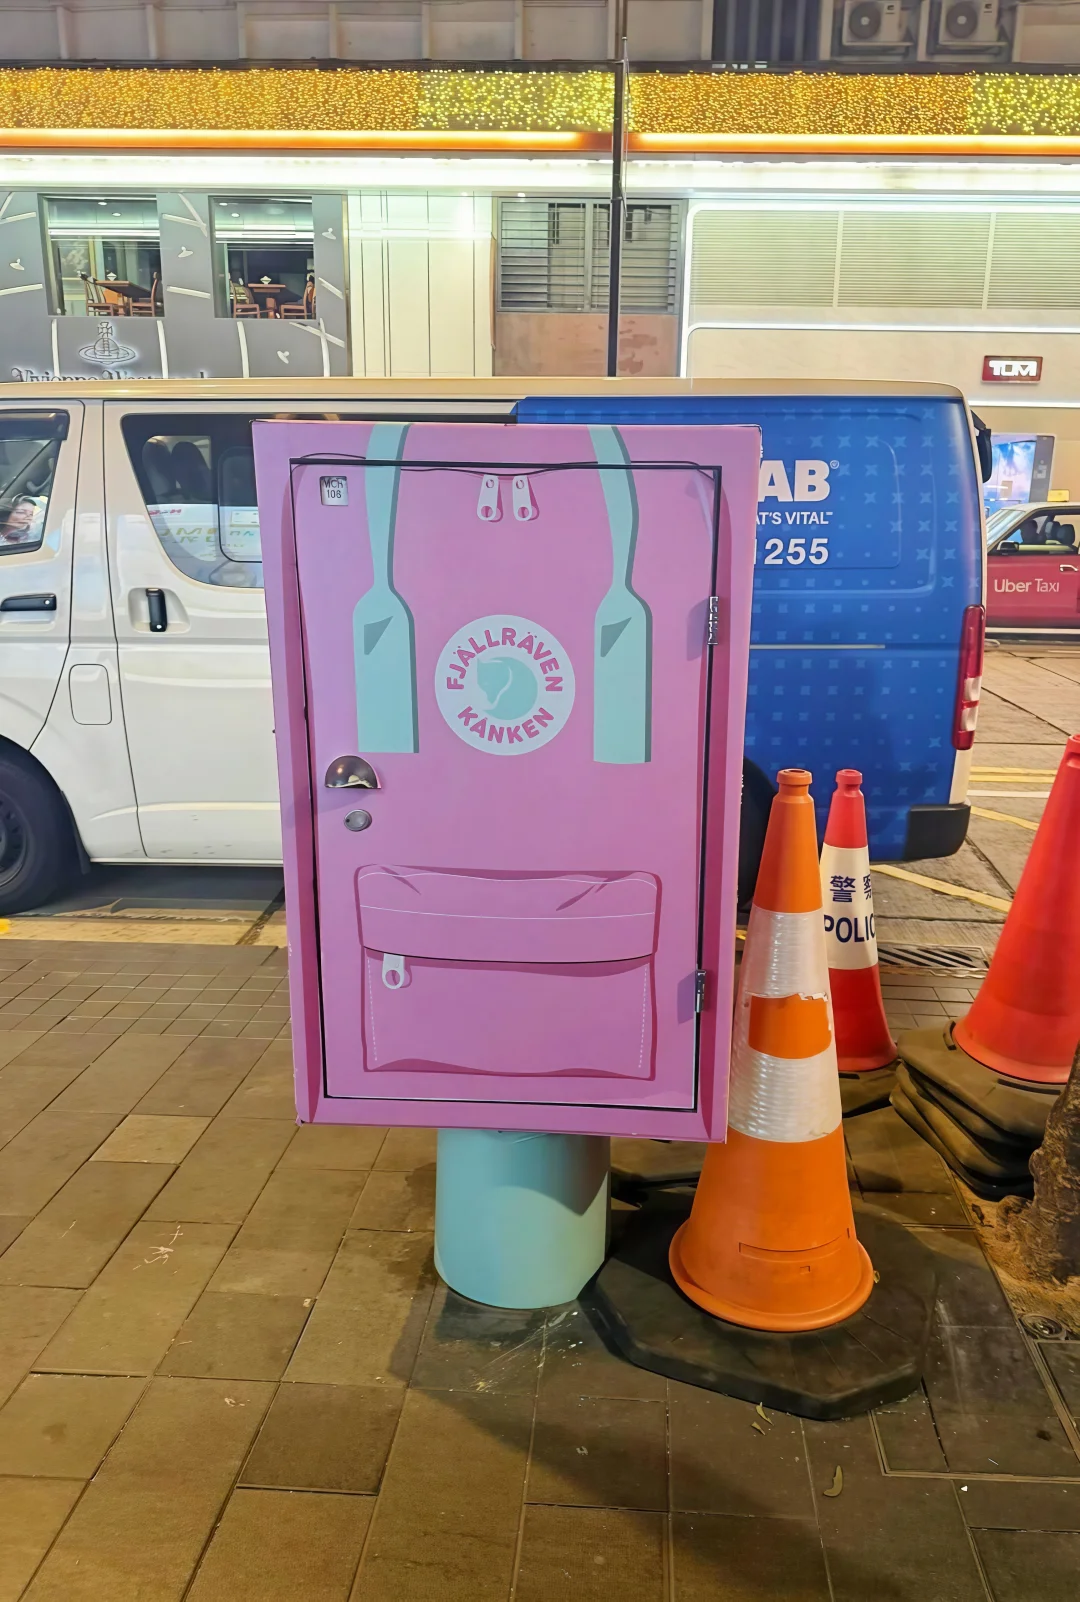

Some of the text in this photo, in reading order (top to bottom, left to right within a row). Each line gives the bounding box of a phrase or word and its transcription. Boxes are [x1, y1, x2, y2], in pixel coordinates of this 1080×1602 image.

[764, 538, 829, 565] 255
[994, 578, 1060, 593] Uber Taxi
[446, 627, 563, 692] FJÄLLRÄVEN
